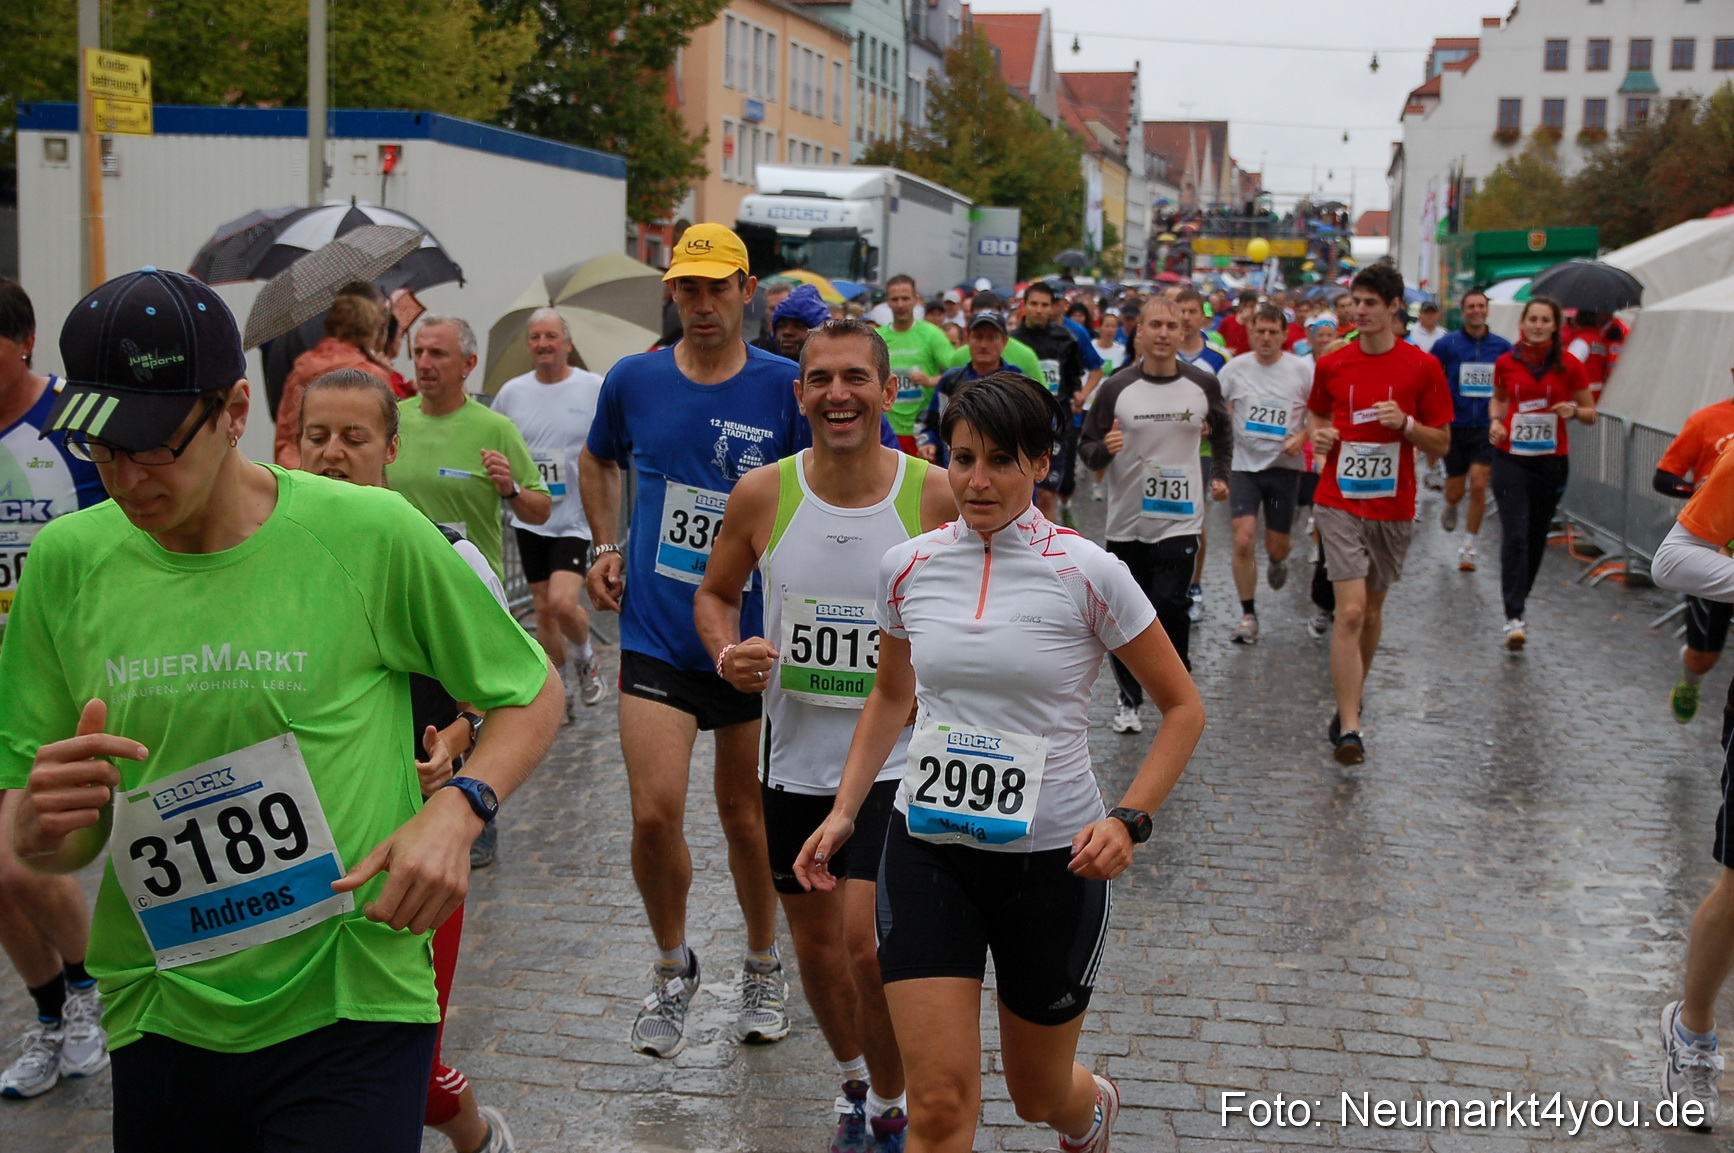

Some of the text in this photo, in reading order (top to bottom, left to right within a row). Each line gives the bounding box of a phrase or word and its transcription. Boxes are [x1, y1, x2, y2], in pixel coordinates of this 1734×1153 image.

[687, 239, 714, 249] LCL
[129, 353, 153, 366] just
[141, 355, 185, 369] sports
[1250, 406, 1286, 426] 2218
[710, 418, 774, 439] 12. NEUMARKTER
[721, 427, 764, 443] STADTLAUF
[1514, 425, 1553, 440] 2376
[1343, 456, 1392, 478] 2373
[1145, 478, 1189, 500] 3131
[816, 604, 865, 617] BOCK
[790, 624, 880, 669] 5013
[187, 679, 255, 692] WOHNEN.
[262, 680, 307, 692] LEBEN.
[810, 673, 864, 693] Roland
[948, 732, 1001, 750] BOCK
[153, 767, 236, 811] BOCK
[915, 756, 1026, 815] 2998
[129, 792, 309, 897] 3189
[190, 885, 295, 934] Andreas
